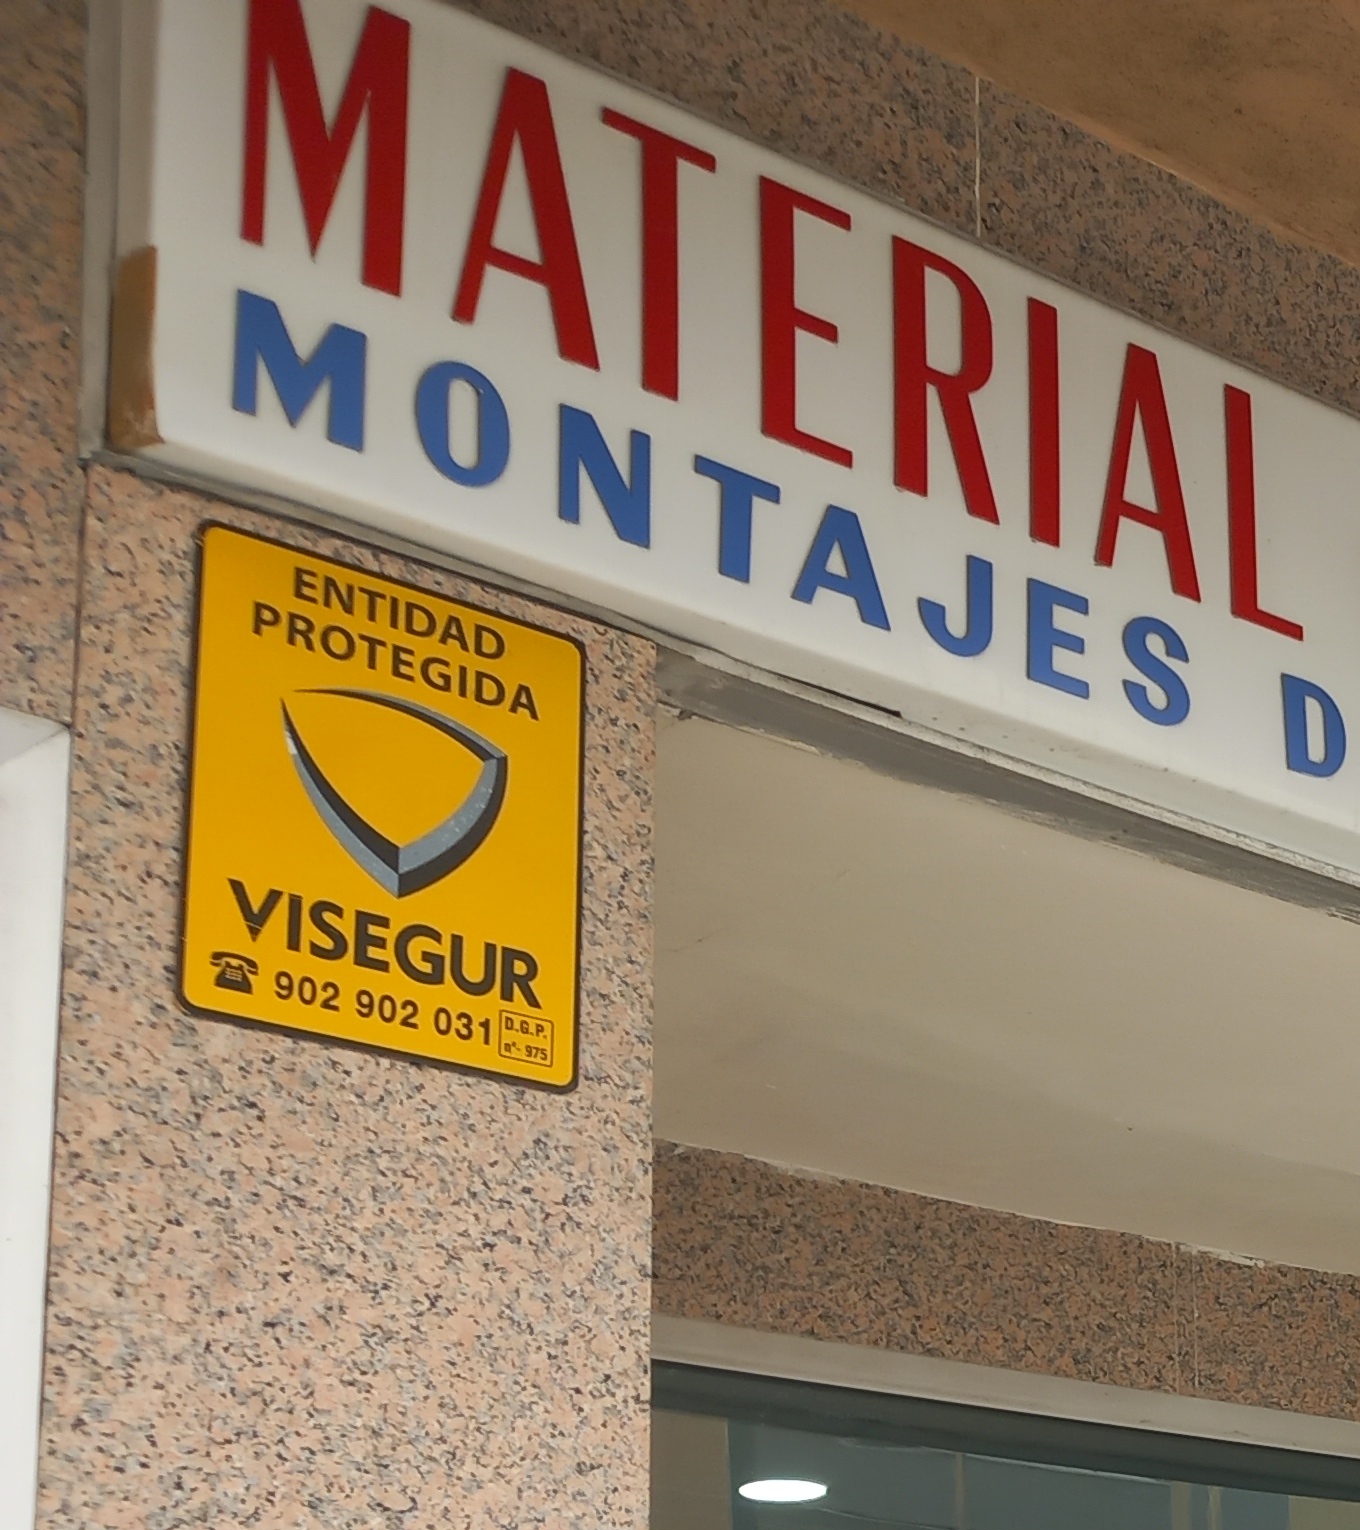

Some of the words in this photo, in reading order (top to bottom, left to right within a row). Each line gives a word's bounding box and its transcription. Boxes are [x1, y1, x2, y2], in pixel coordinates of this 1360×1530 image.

[240, 0, 1304, 641] MATERIAL
[232, 289, 1191, 726] MONTAJES
[251, 601, 540, 721] PROTEGIDA
[293, 565, 506, 661] ENTIDAD
[226, 876, 542, 1010] VISEGUR
[274, 970, 341, 1012] 902
[355, 987, 419, 1030] 902
[433, 1005, 493, 1047] 031
[525, 1044, 548, 1061] 975
